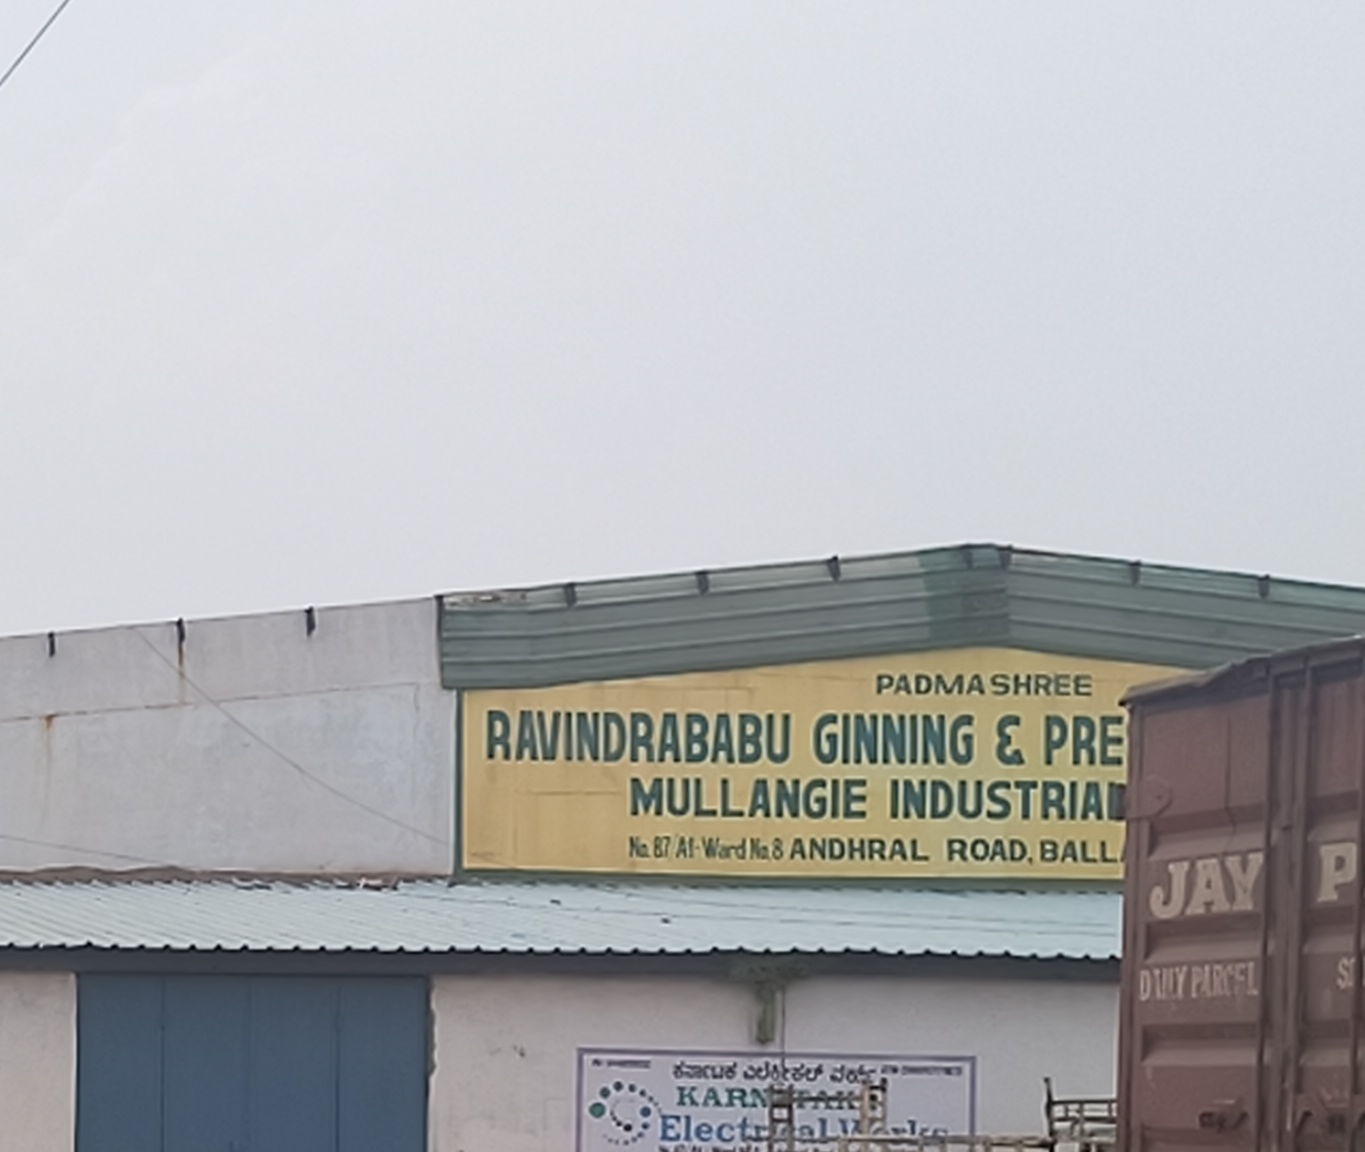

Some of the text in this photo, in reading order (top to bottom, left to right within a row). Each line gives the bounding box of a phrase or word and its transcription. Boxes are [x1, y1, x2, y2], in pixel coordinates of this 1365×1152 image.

[486, 709, 792, 764] RAVINDRABABU
[813, 713, 975, 766] GINNING
[996, 714, 1025, 766] &
[629, 776, 867, 819] MULLANGIE
[790, 838, 930, 862] ANDHRAL
[1040, 840, 1125, 863] BALL
[1149, 852, 1264, 919] JAY
[676, 1086, 879, 1110] KARNTAK
